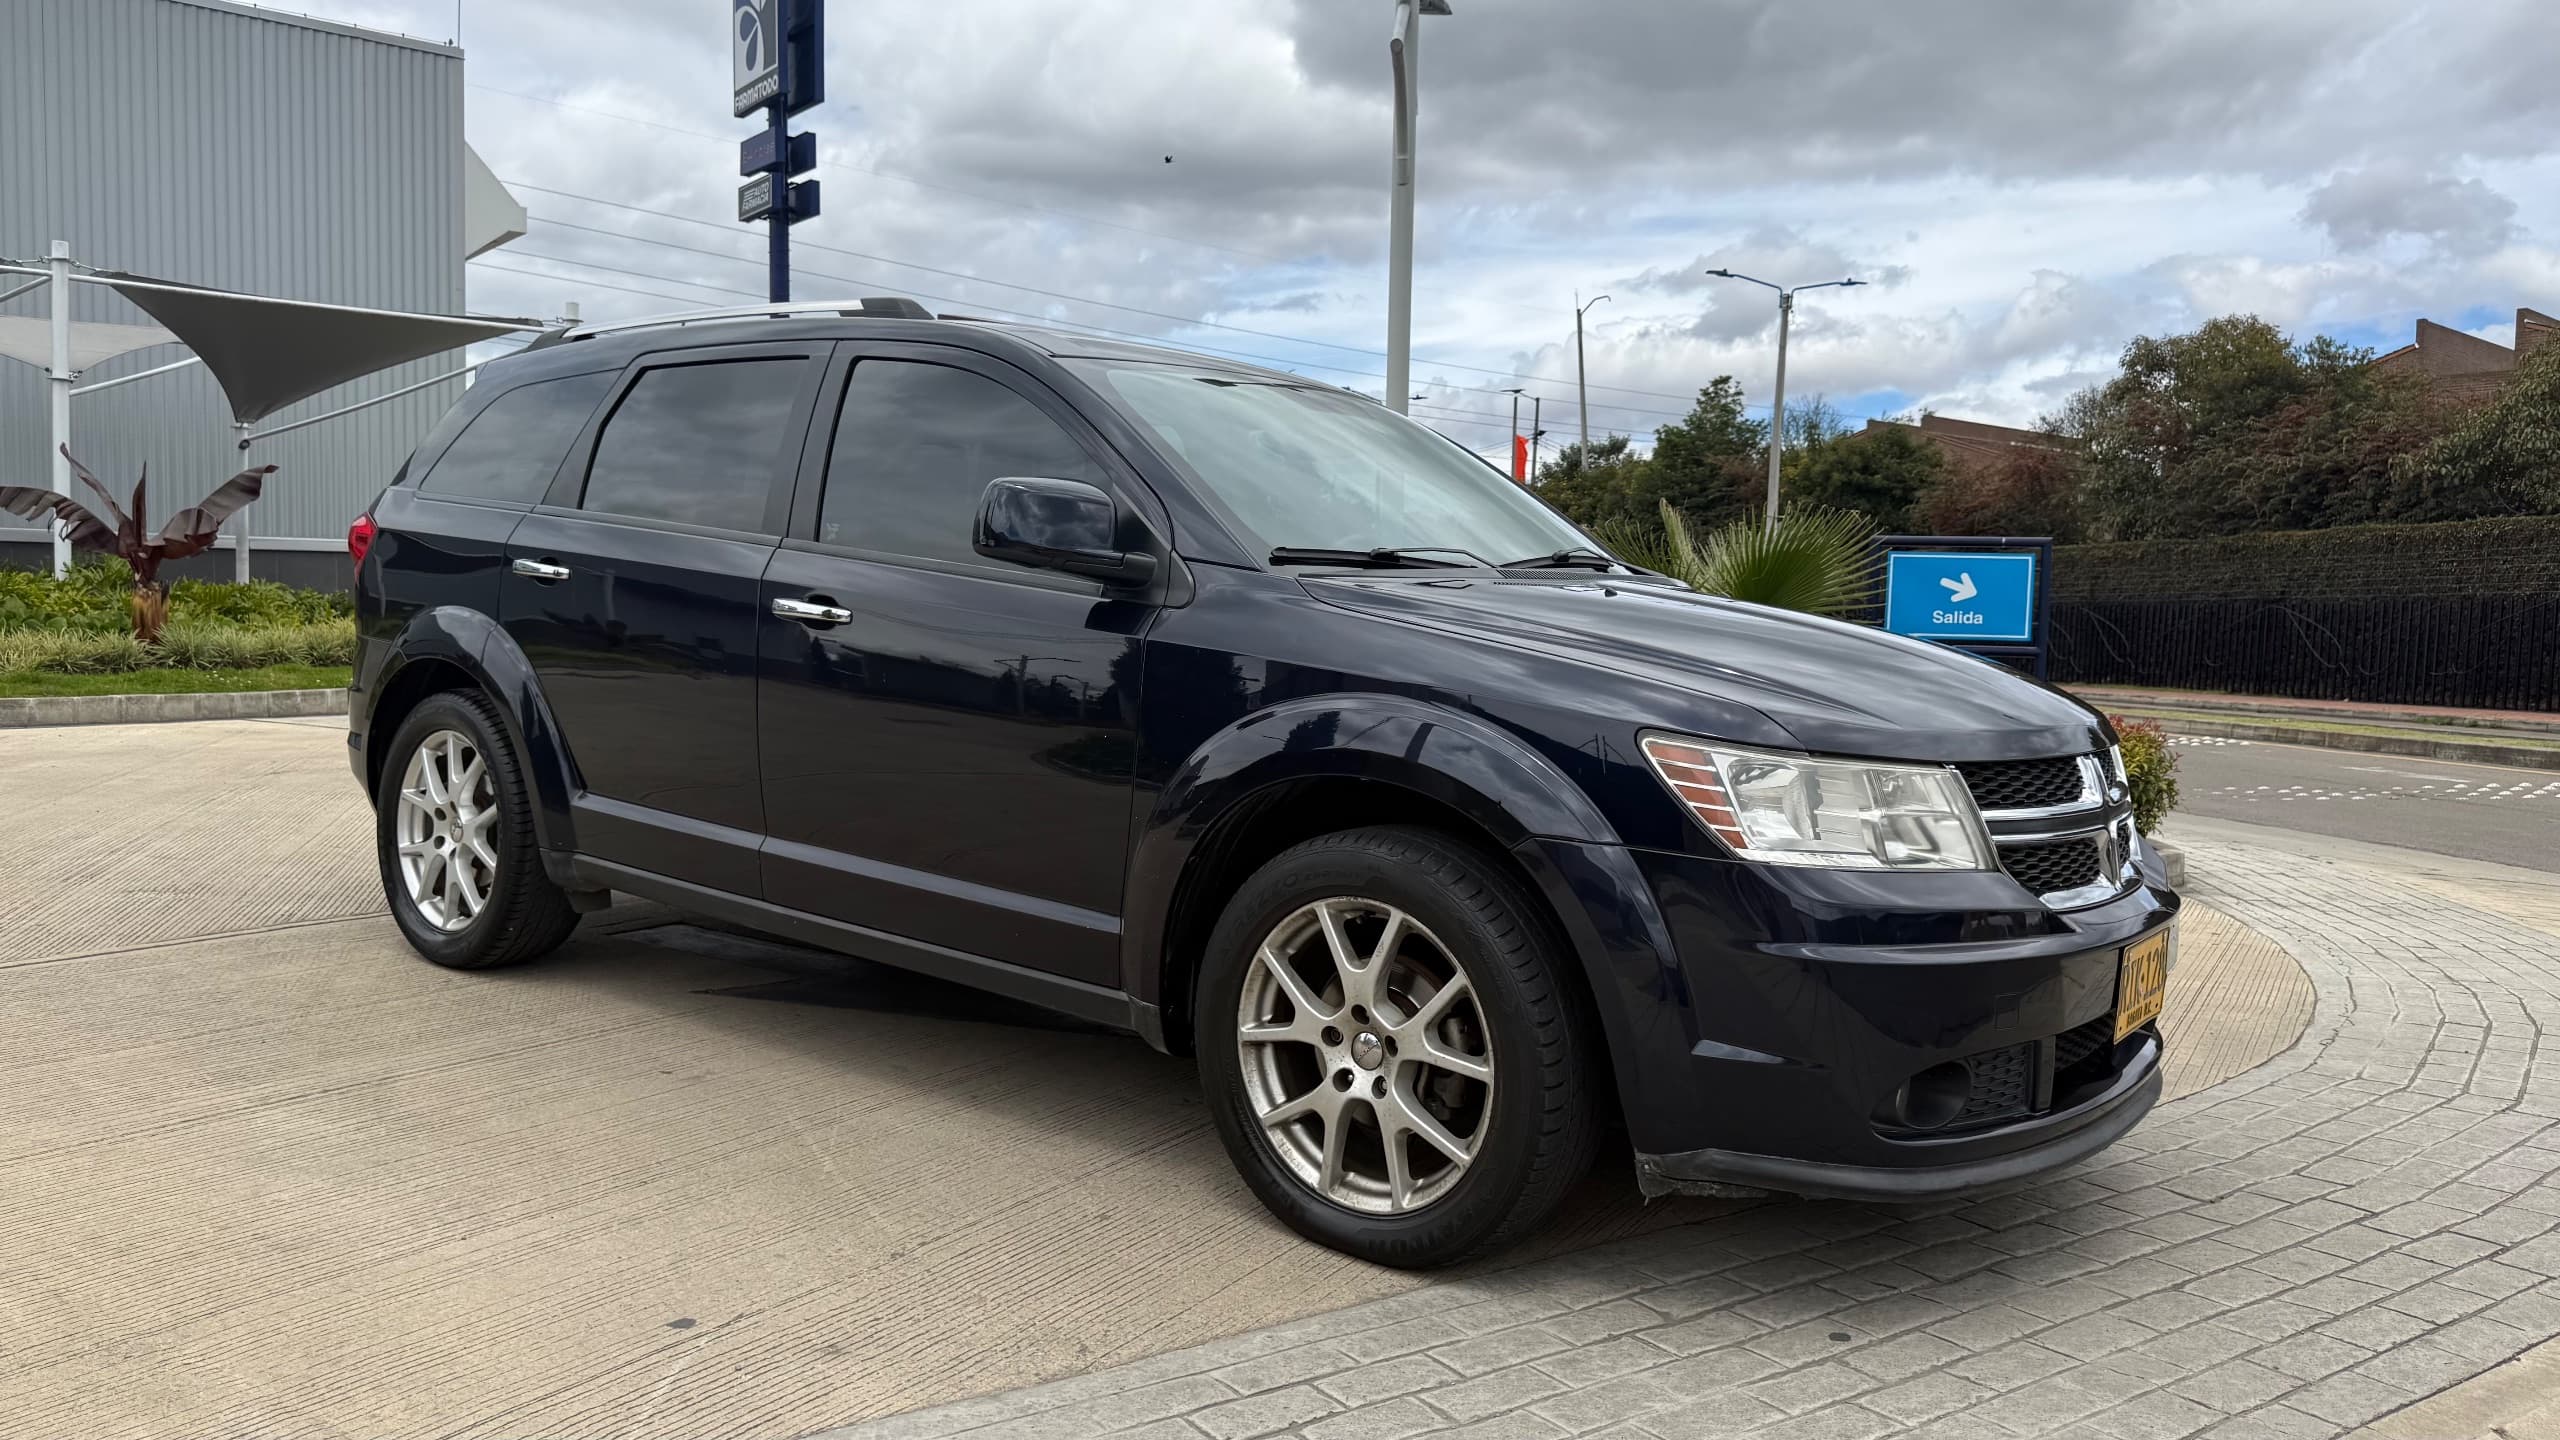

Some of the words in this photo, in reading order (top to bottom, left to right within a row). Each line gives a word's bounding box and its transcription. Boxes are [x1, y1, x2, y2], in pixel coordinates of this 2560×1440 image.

[735, 74, 779, 113] FARMATODO
[753, 181, 770, 196] AUTO
[1932, 609, 1984, 625] Salida
